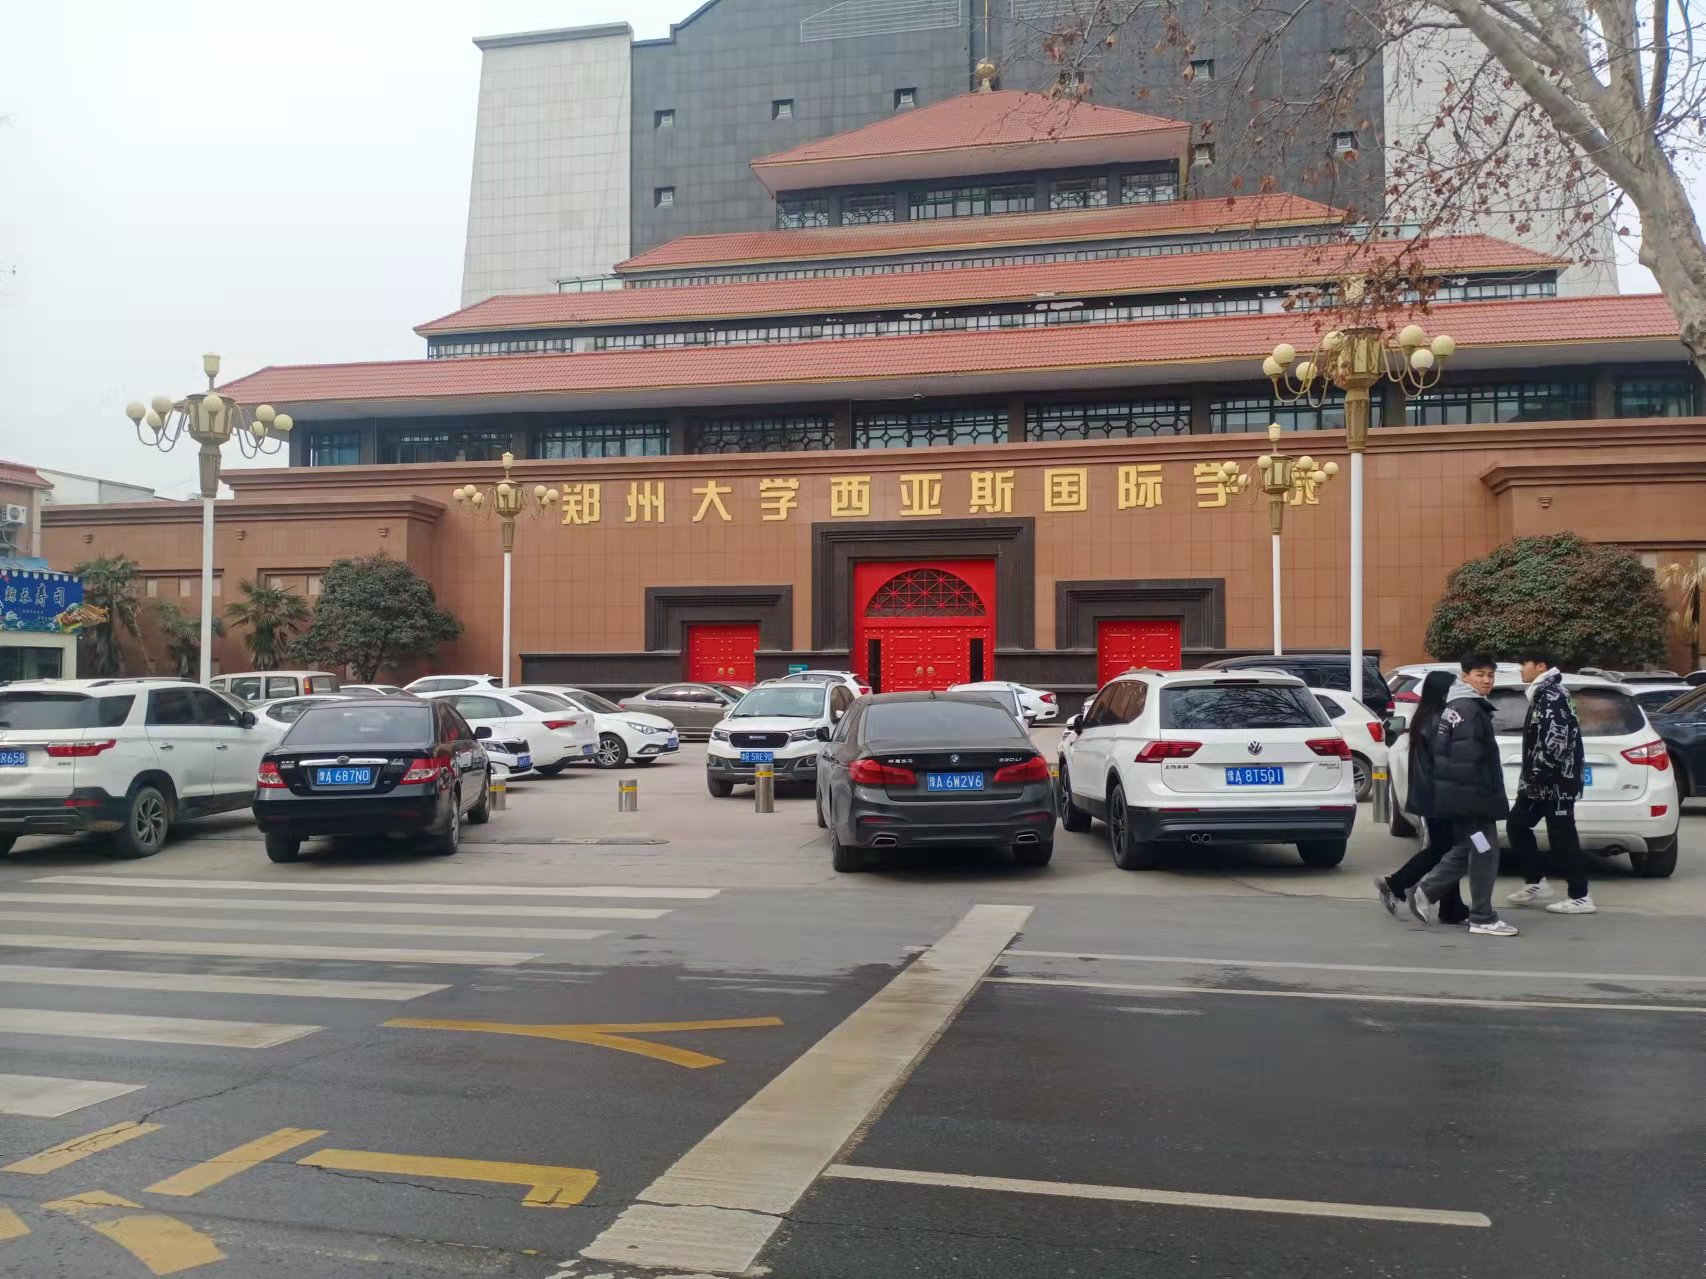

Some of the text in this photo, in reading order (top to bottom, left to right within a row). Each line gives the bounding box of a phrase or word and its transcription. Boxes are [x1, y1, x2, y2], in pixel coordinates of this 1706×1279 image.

[562, 461, 1320, 525] 郑州大学西亚斯国际学院
[0, 752, 25, 764] R658
